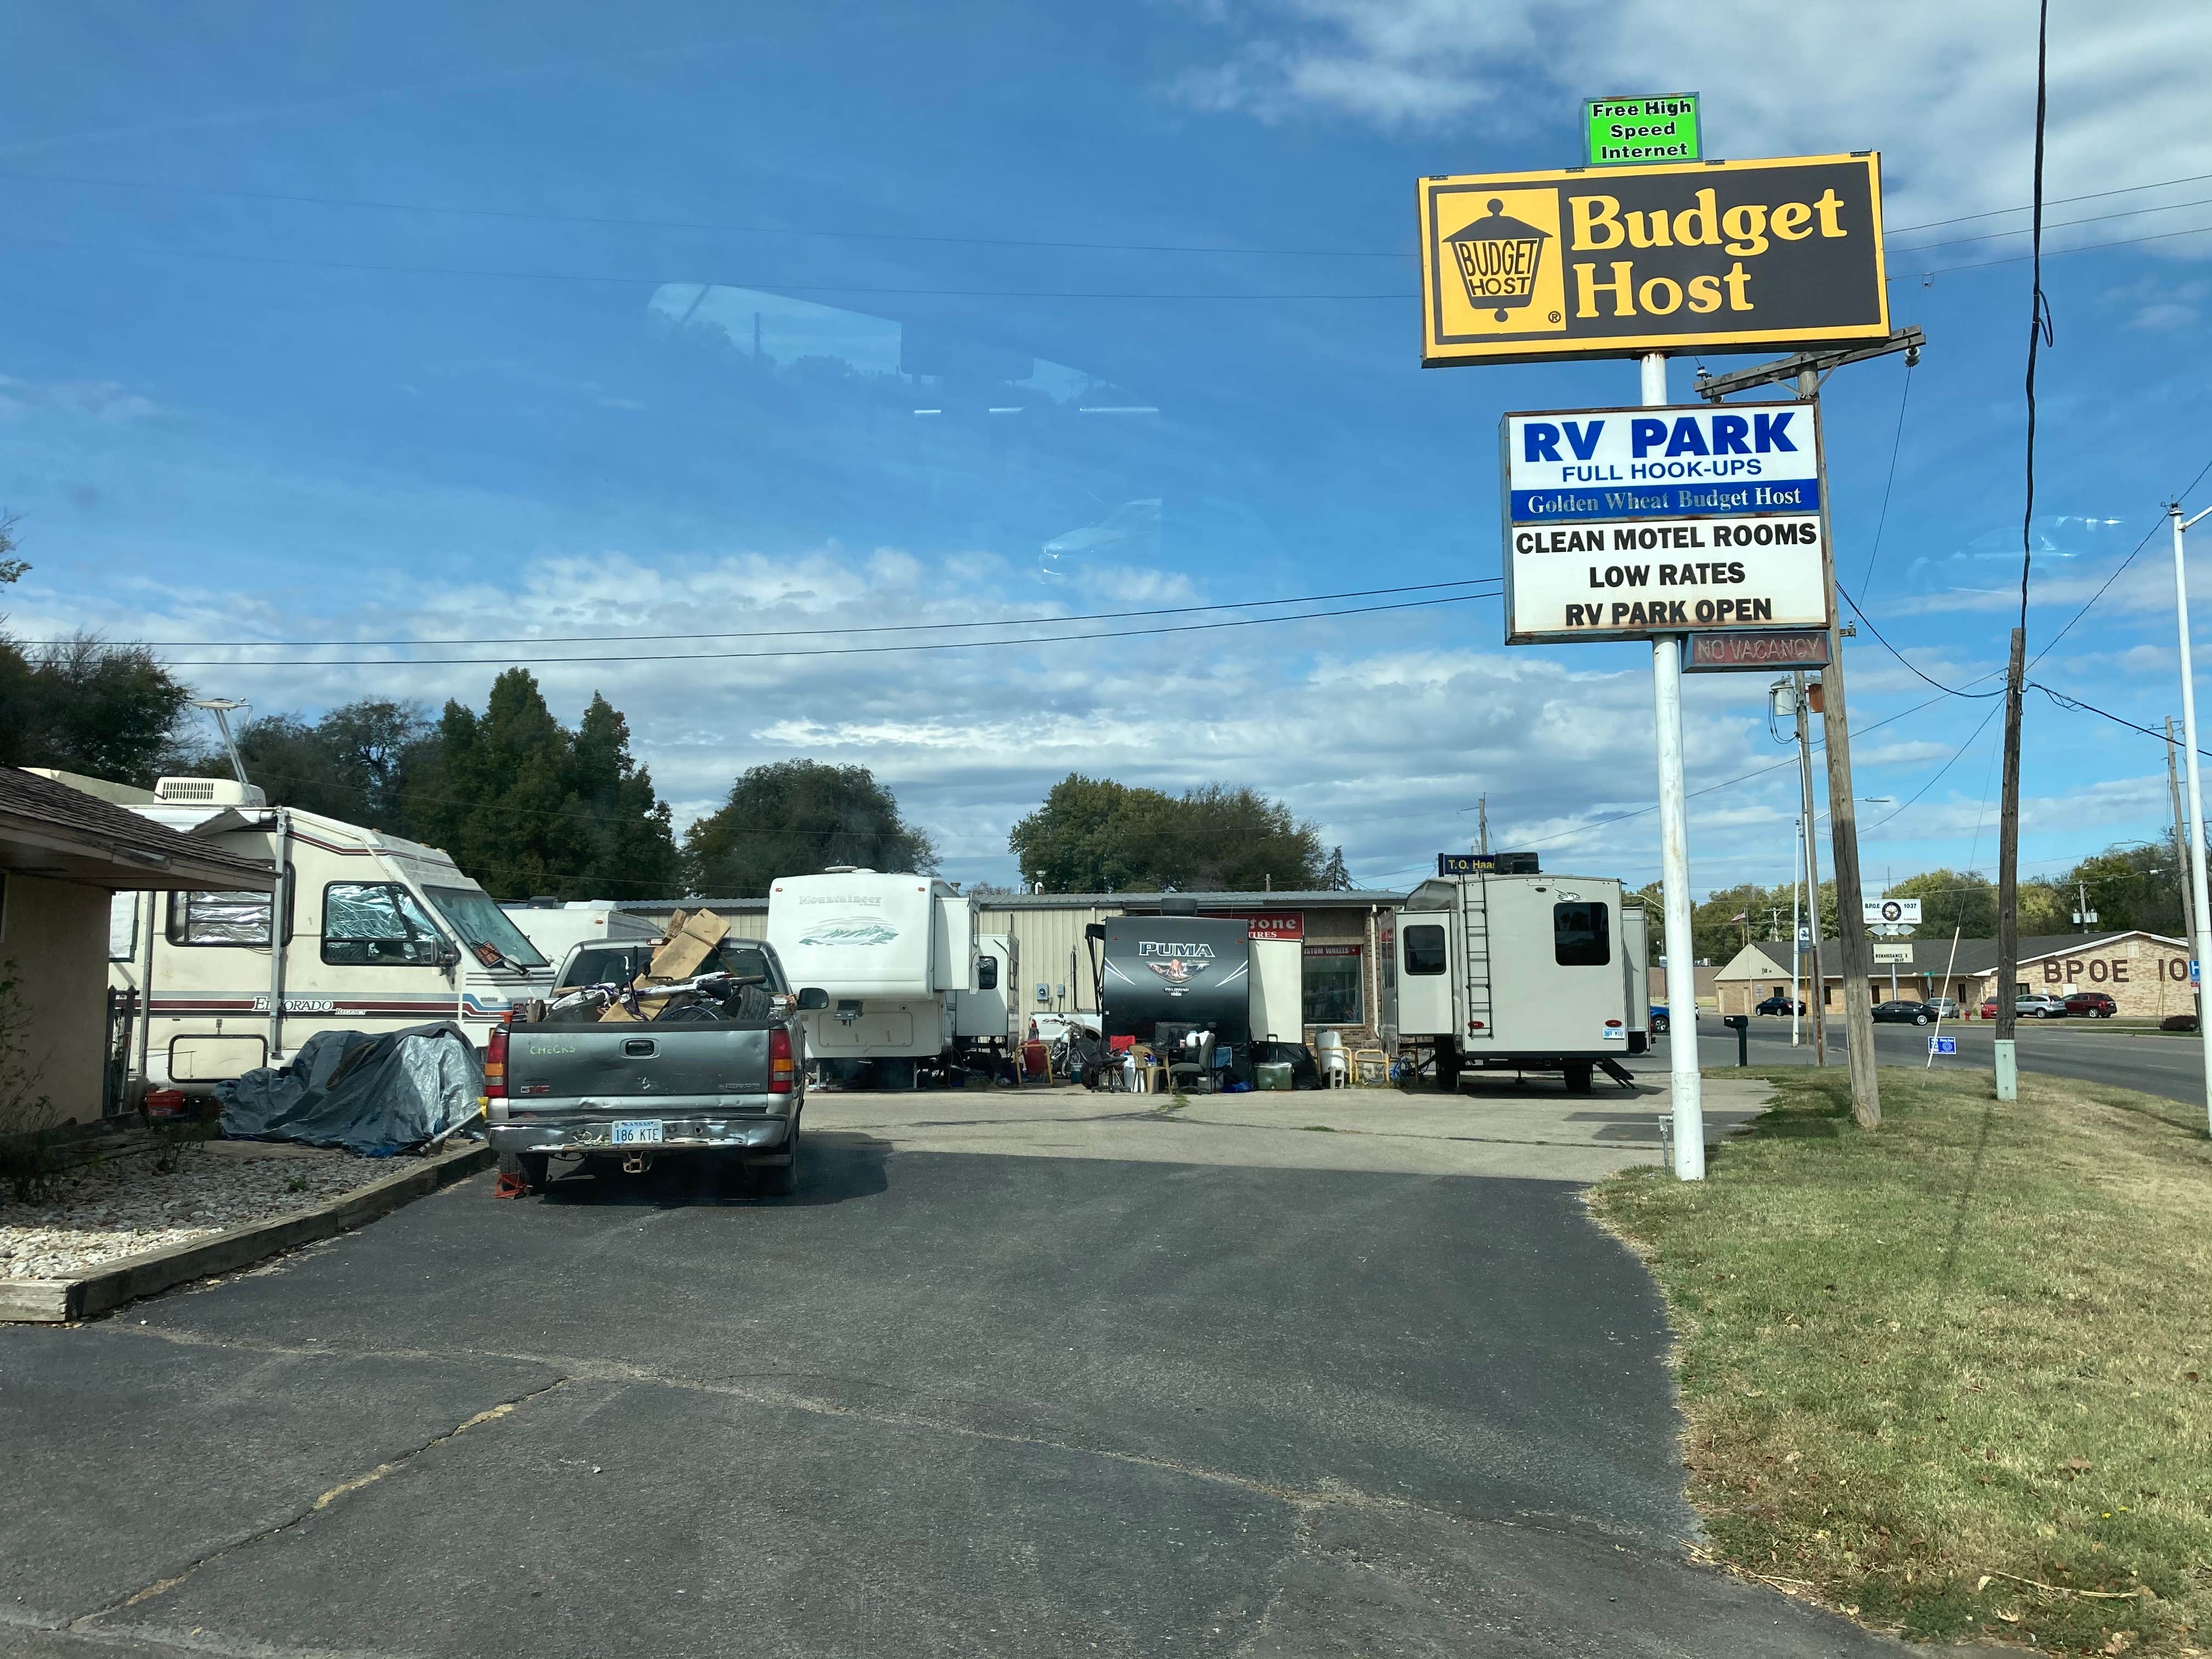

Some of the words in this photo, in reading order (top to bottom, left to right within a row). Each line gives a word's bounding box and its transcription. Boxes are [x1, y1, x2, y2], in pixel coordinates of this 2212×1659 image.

[1593, 104, 1639, 117] Free
[1645, 100, 1691, 117] High
[1611, 121, 1675, 140] Speed
[1601, 143, 1688, 159] Internet
[1568, 188, 1847, 257] Budget
[1458, 240, 1538, 278] BUDGET
[1469, 276, 1531, 296] HOST
[1573, 261, 1754, 318] Host
[1524, 420, 1605, 462] RV
[1631, 411, 1798, 459] PARK
[1562, 464, 1623, 482] FULL
[1631, 458, 1762, 479] HOOK-UPS
[1528, 494, 1599, 514] Golden
[1605, 492, 1669, 510] Wheat
[1679, 488, 1748, 511] Budget
[1755, 486, 1802, 505] Host
[1516, 529, 1604, 554] CLEAN
[1614, 526, 1705, 550] MOTEL
[1714, 522, 1816, 546] ROOMS
[1589, 564, 1650, 588] LOW
[1659, 561, 1746, 585] RATES
[1566, 602, 1603, 626] RV
[1612, 600, 1689, 624] PARK
[1696, 598, 1772, 621] OPEN
[1697, 639, 1724, 659] NO
[1729, 637, 1820, 660] VACANCY
[799, 895, 882, 905] Mountaineer
[1138, 941, 1216, 957] PUMA
[2043, 959, 2130, 984] BPOE
[529, 1045, 575, 1054] CHECKS
[520, 1085, 550, 1093] GMC
[616, 1129, 634, 1142] 186
[640, 1128, 659, 1141] KTE
